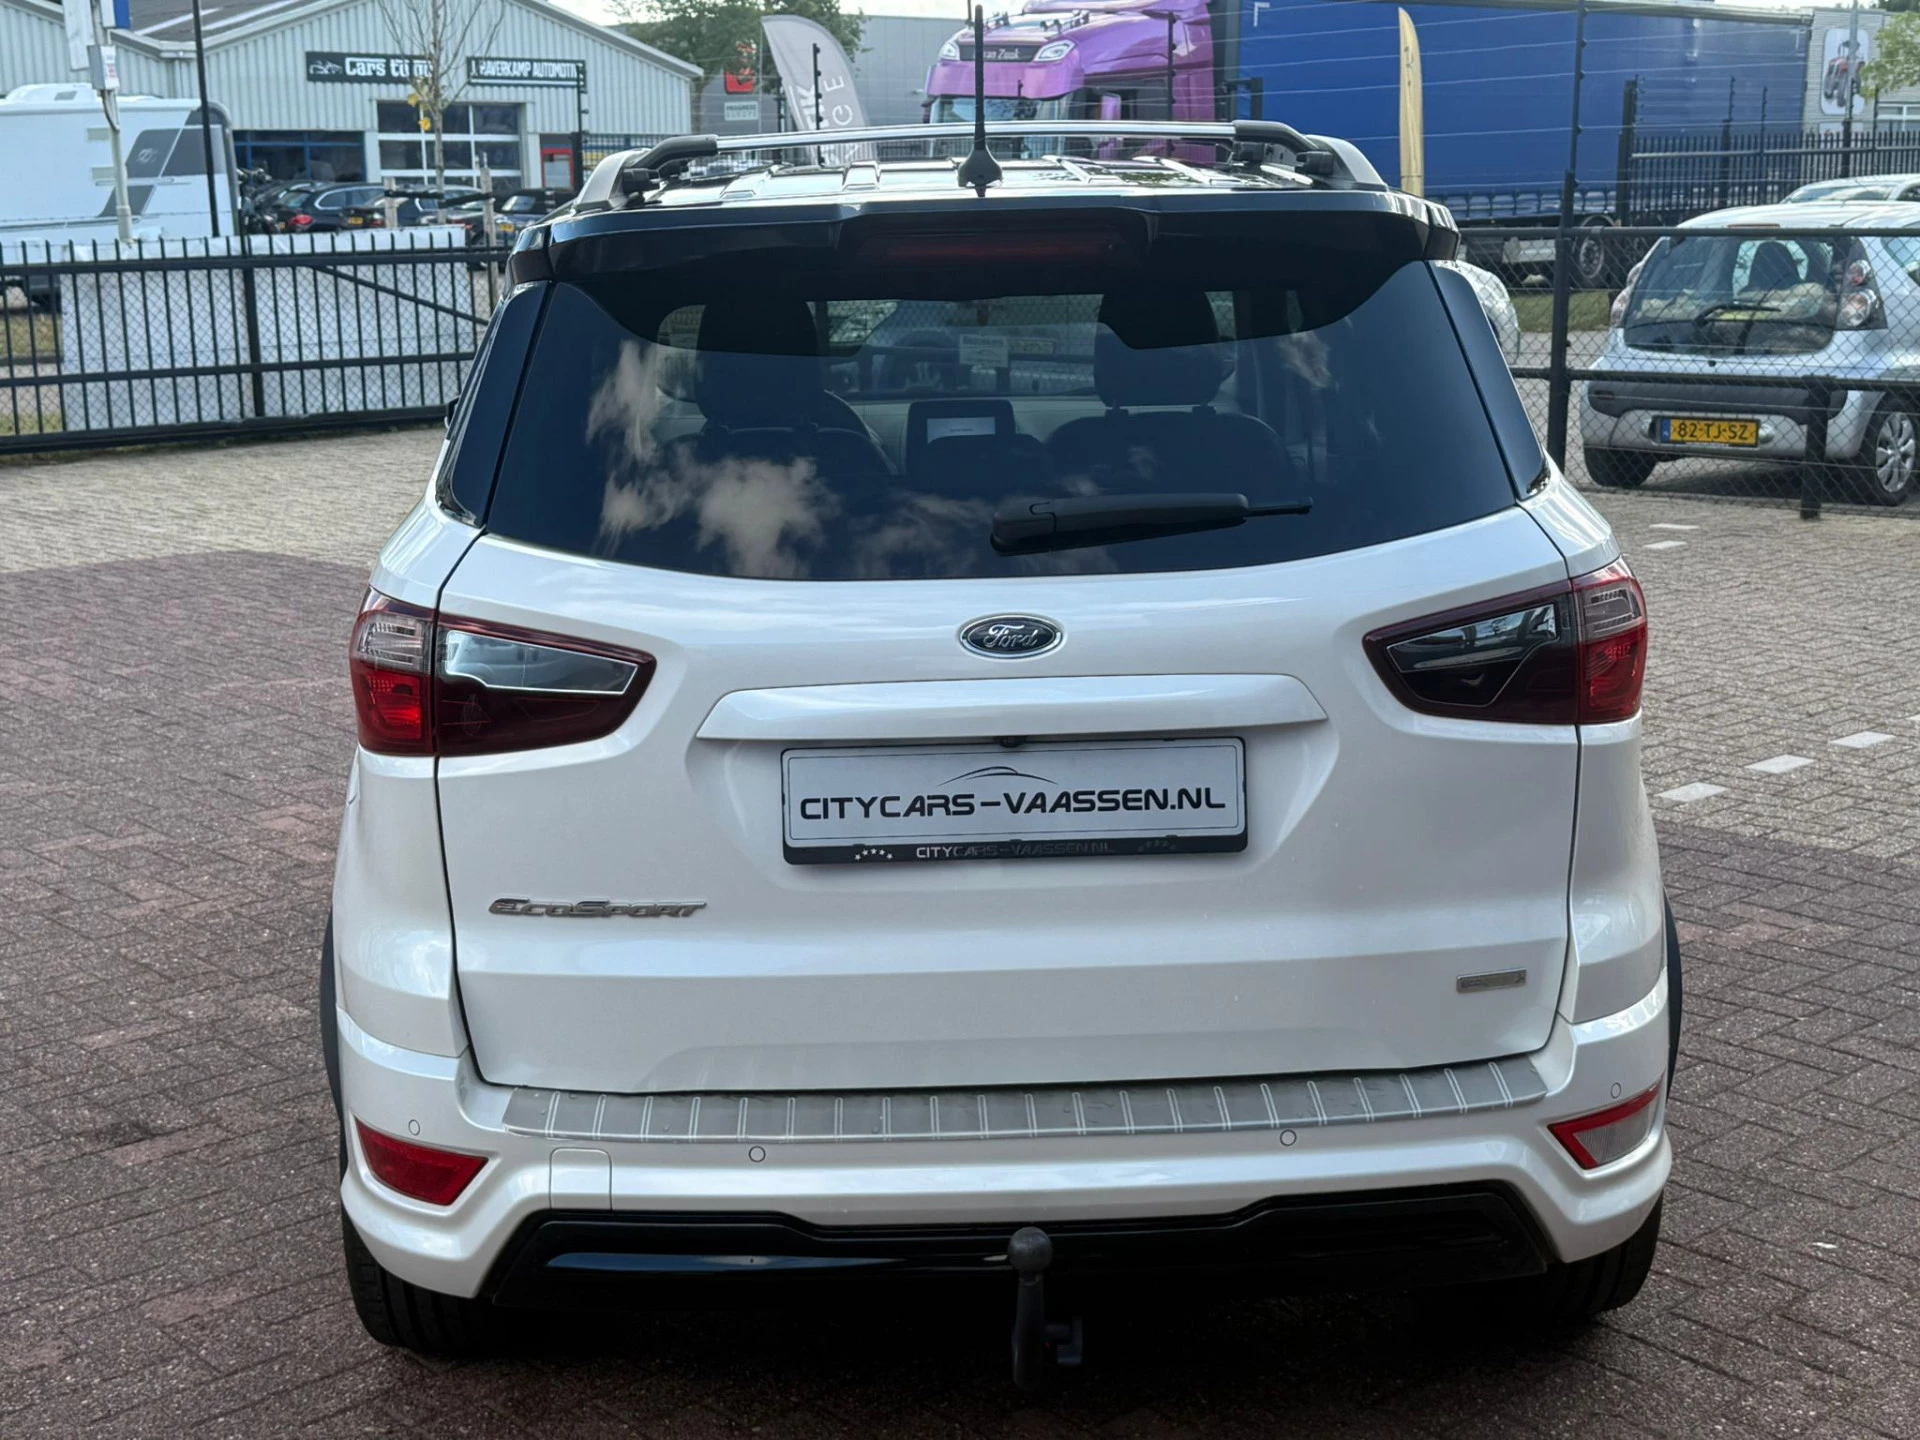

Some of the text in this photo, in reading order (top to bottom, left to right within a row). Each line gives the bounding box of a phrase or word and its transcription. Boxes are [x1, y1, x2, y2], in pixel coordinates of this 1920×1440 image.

[345, 57, 386, 77] Cars
[390, 58, 410, 77] to
[1677, 421, 1749, 440] 82-TJ-SZ
[983, 624, 1039, 648] Ford
[800, 787, 1226, 821] CITYCARS-VAASSEN.NL
[915, 841, 1116, 859] CITYCARS-VAASSEN.NL
